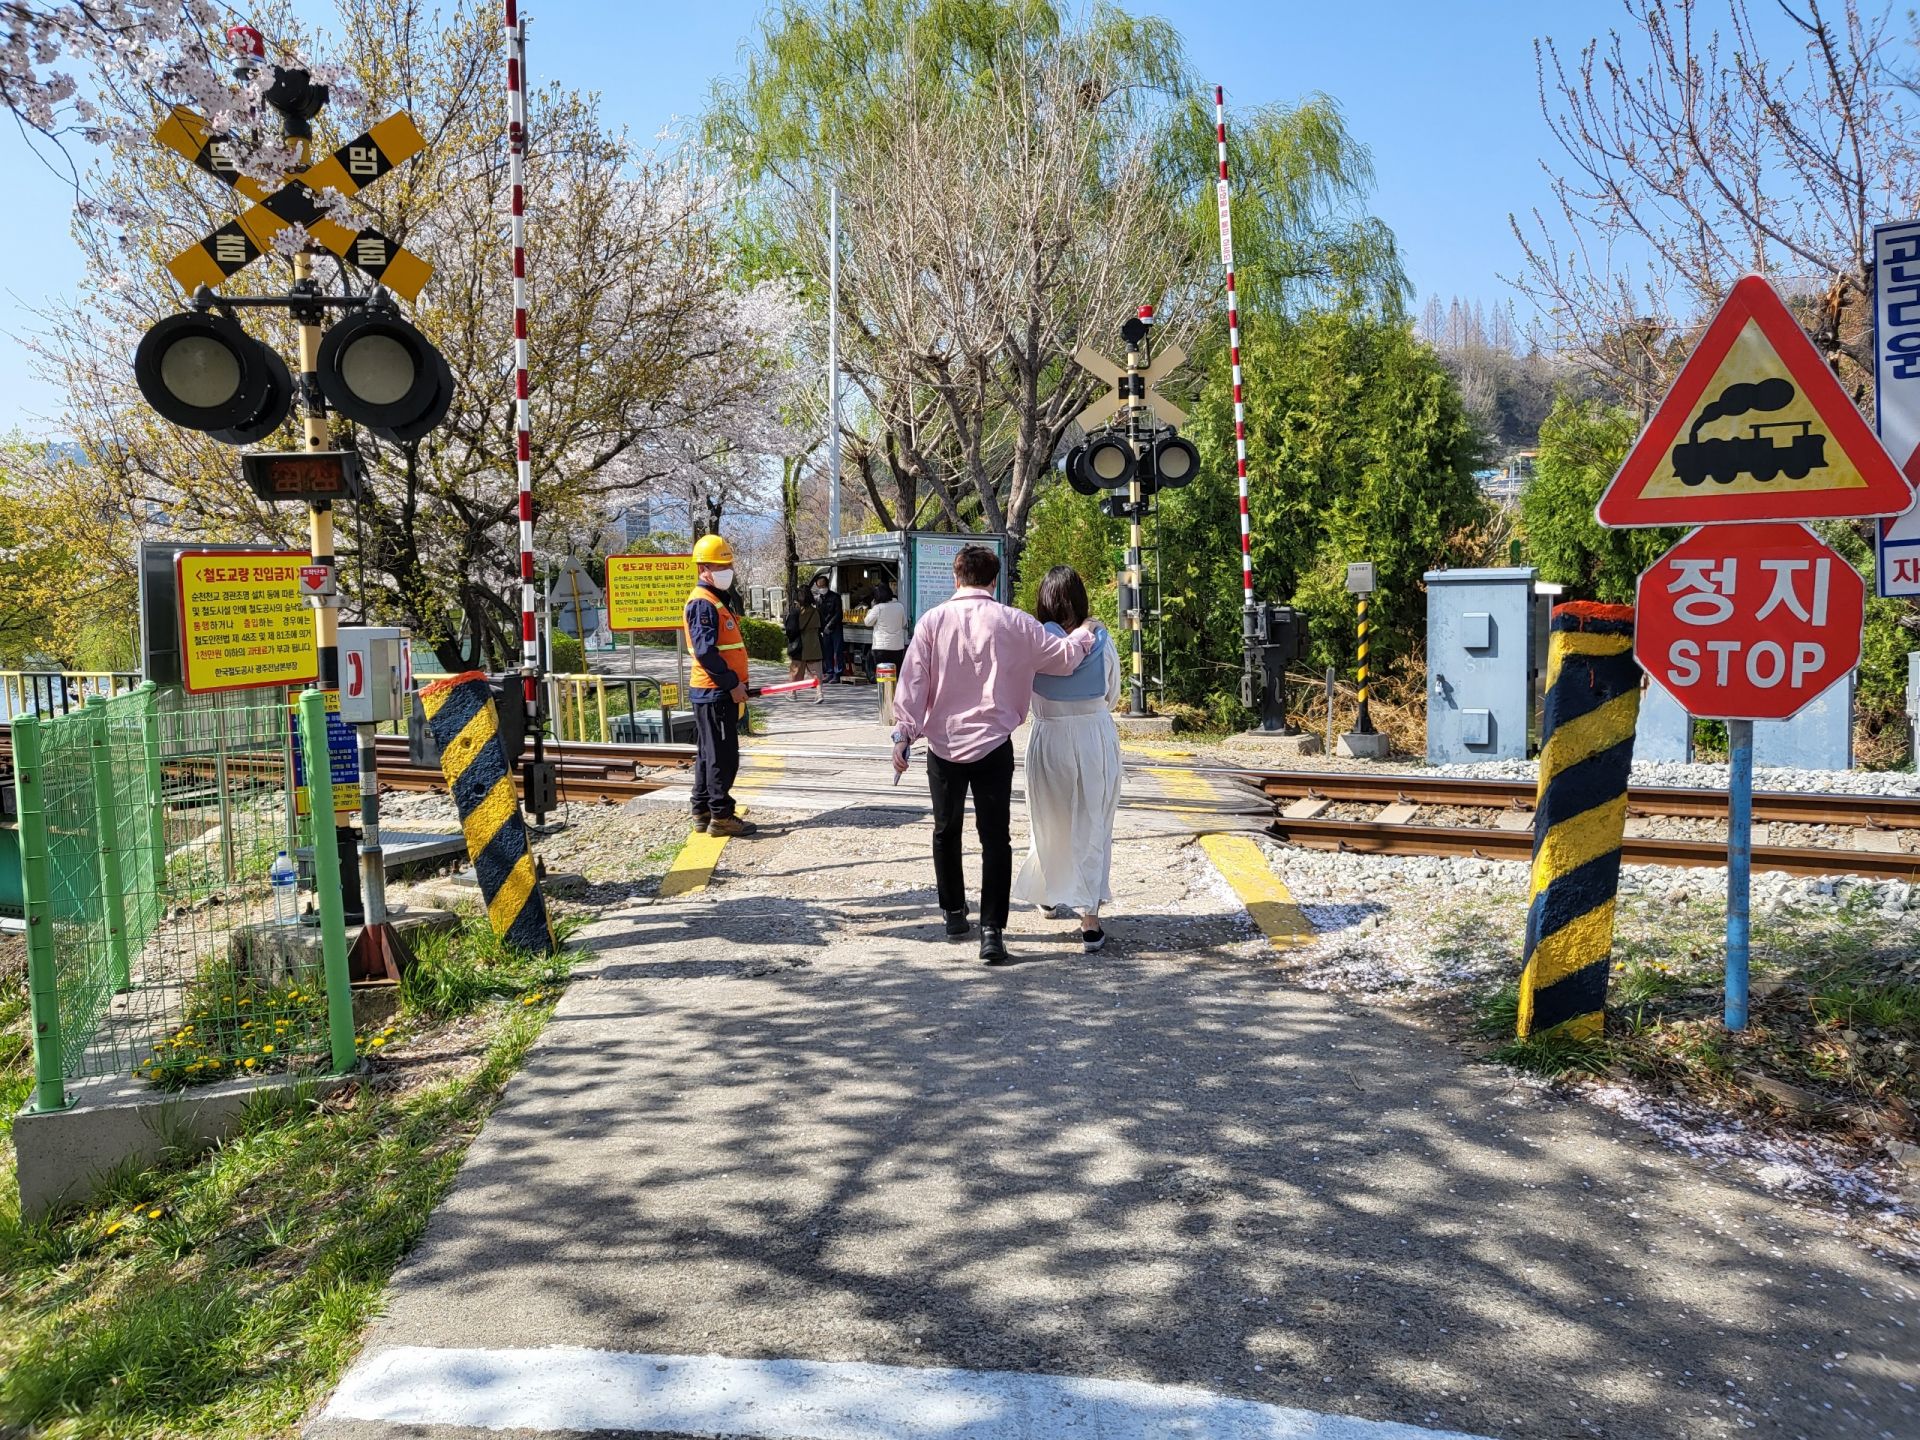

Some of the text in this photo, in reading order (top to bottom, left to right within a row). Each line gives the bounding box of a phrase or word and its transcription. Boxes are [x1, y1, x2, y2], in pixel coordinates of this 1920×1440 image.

[350, 146, 377, 175] 멈
[216, 234, 246, 262] 춤
[356, 238, 387, 265] 춤
[282, 589, 294, 598] 따른
[1667, 558, 1831, 626] 정지
[1667, 639, 1826, 689] STOP
